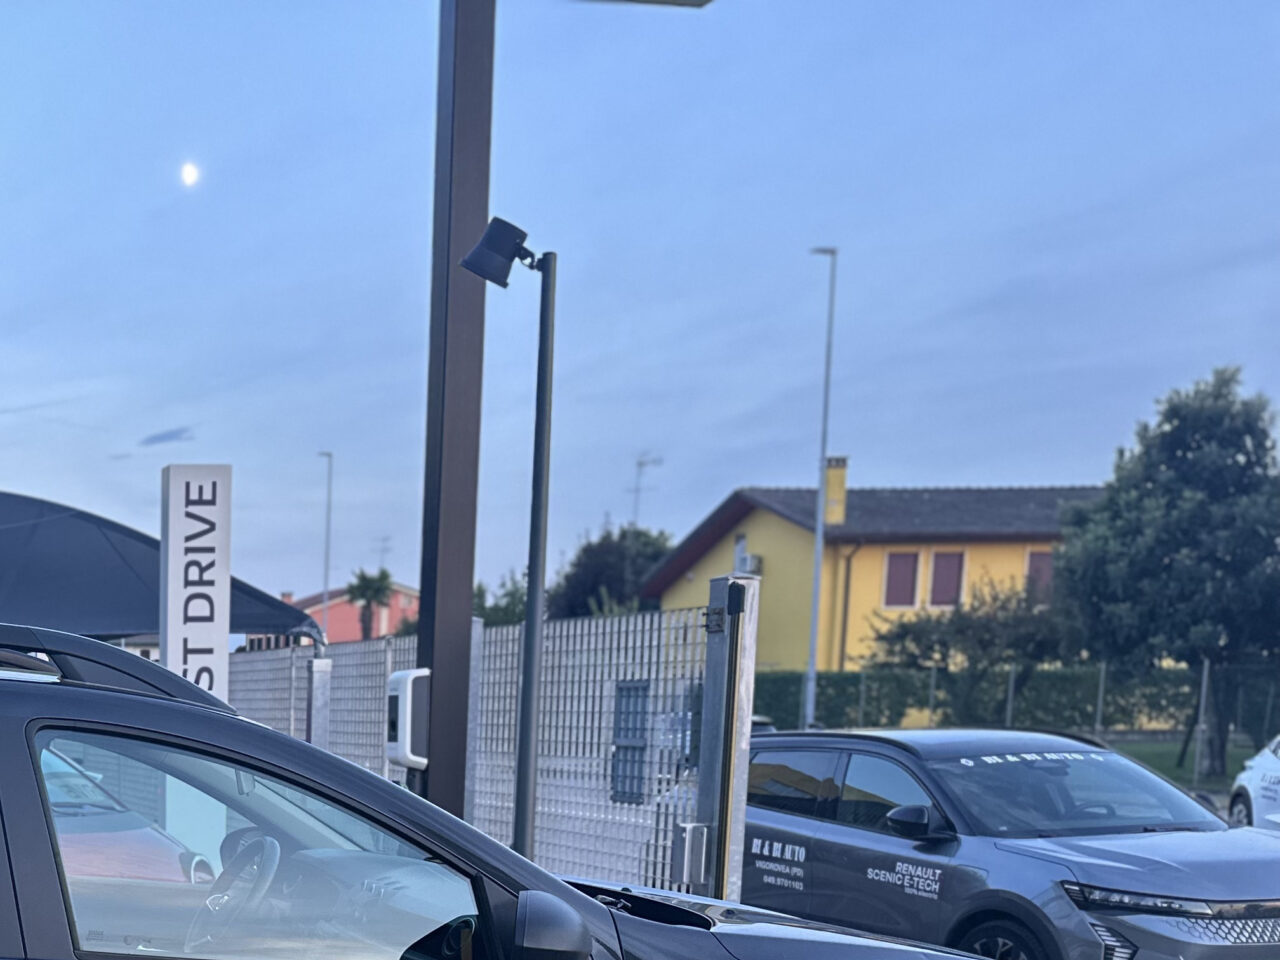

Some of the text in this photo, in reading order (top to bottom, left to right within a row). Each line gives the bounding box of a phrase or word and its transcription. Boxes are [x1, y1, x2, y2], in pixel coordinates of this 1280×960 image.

[183, 480, 218, 625] DRIVE
[751, 838, 807, 863] BI & BI AUTO
[867, 867, 941, 894] SCENIC E-TECH
[895, 861, 942, 881] RENAULT
